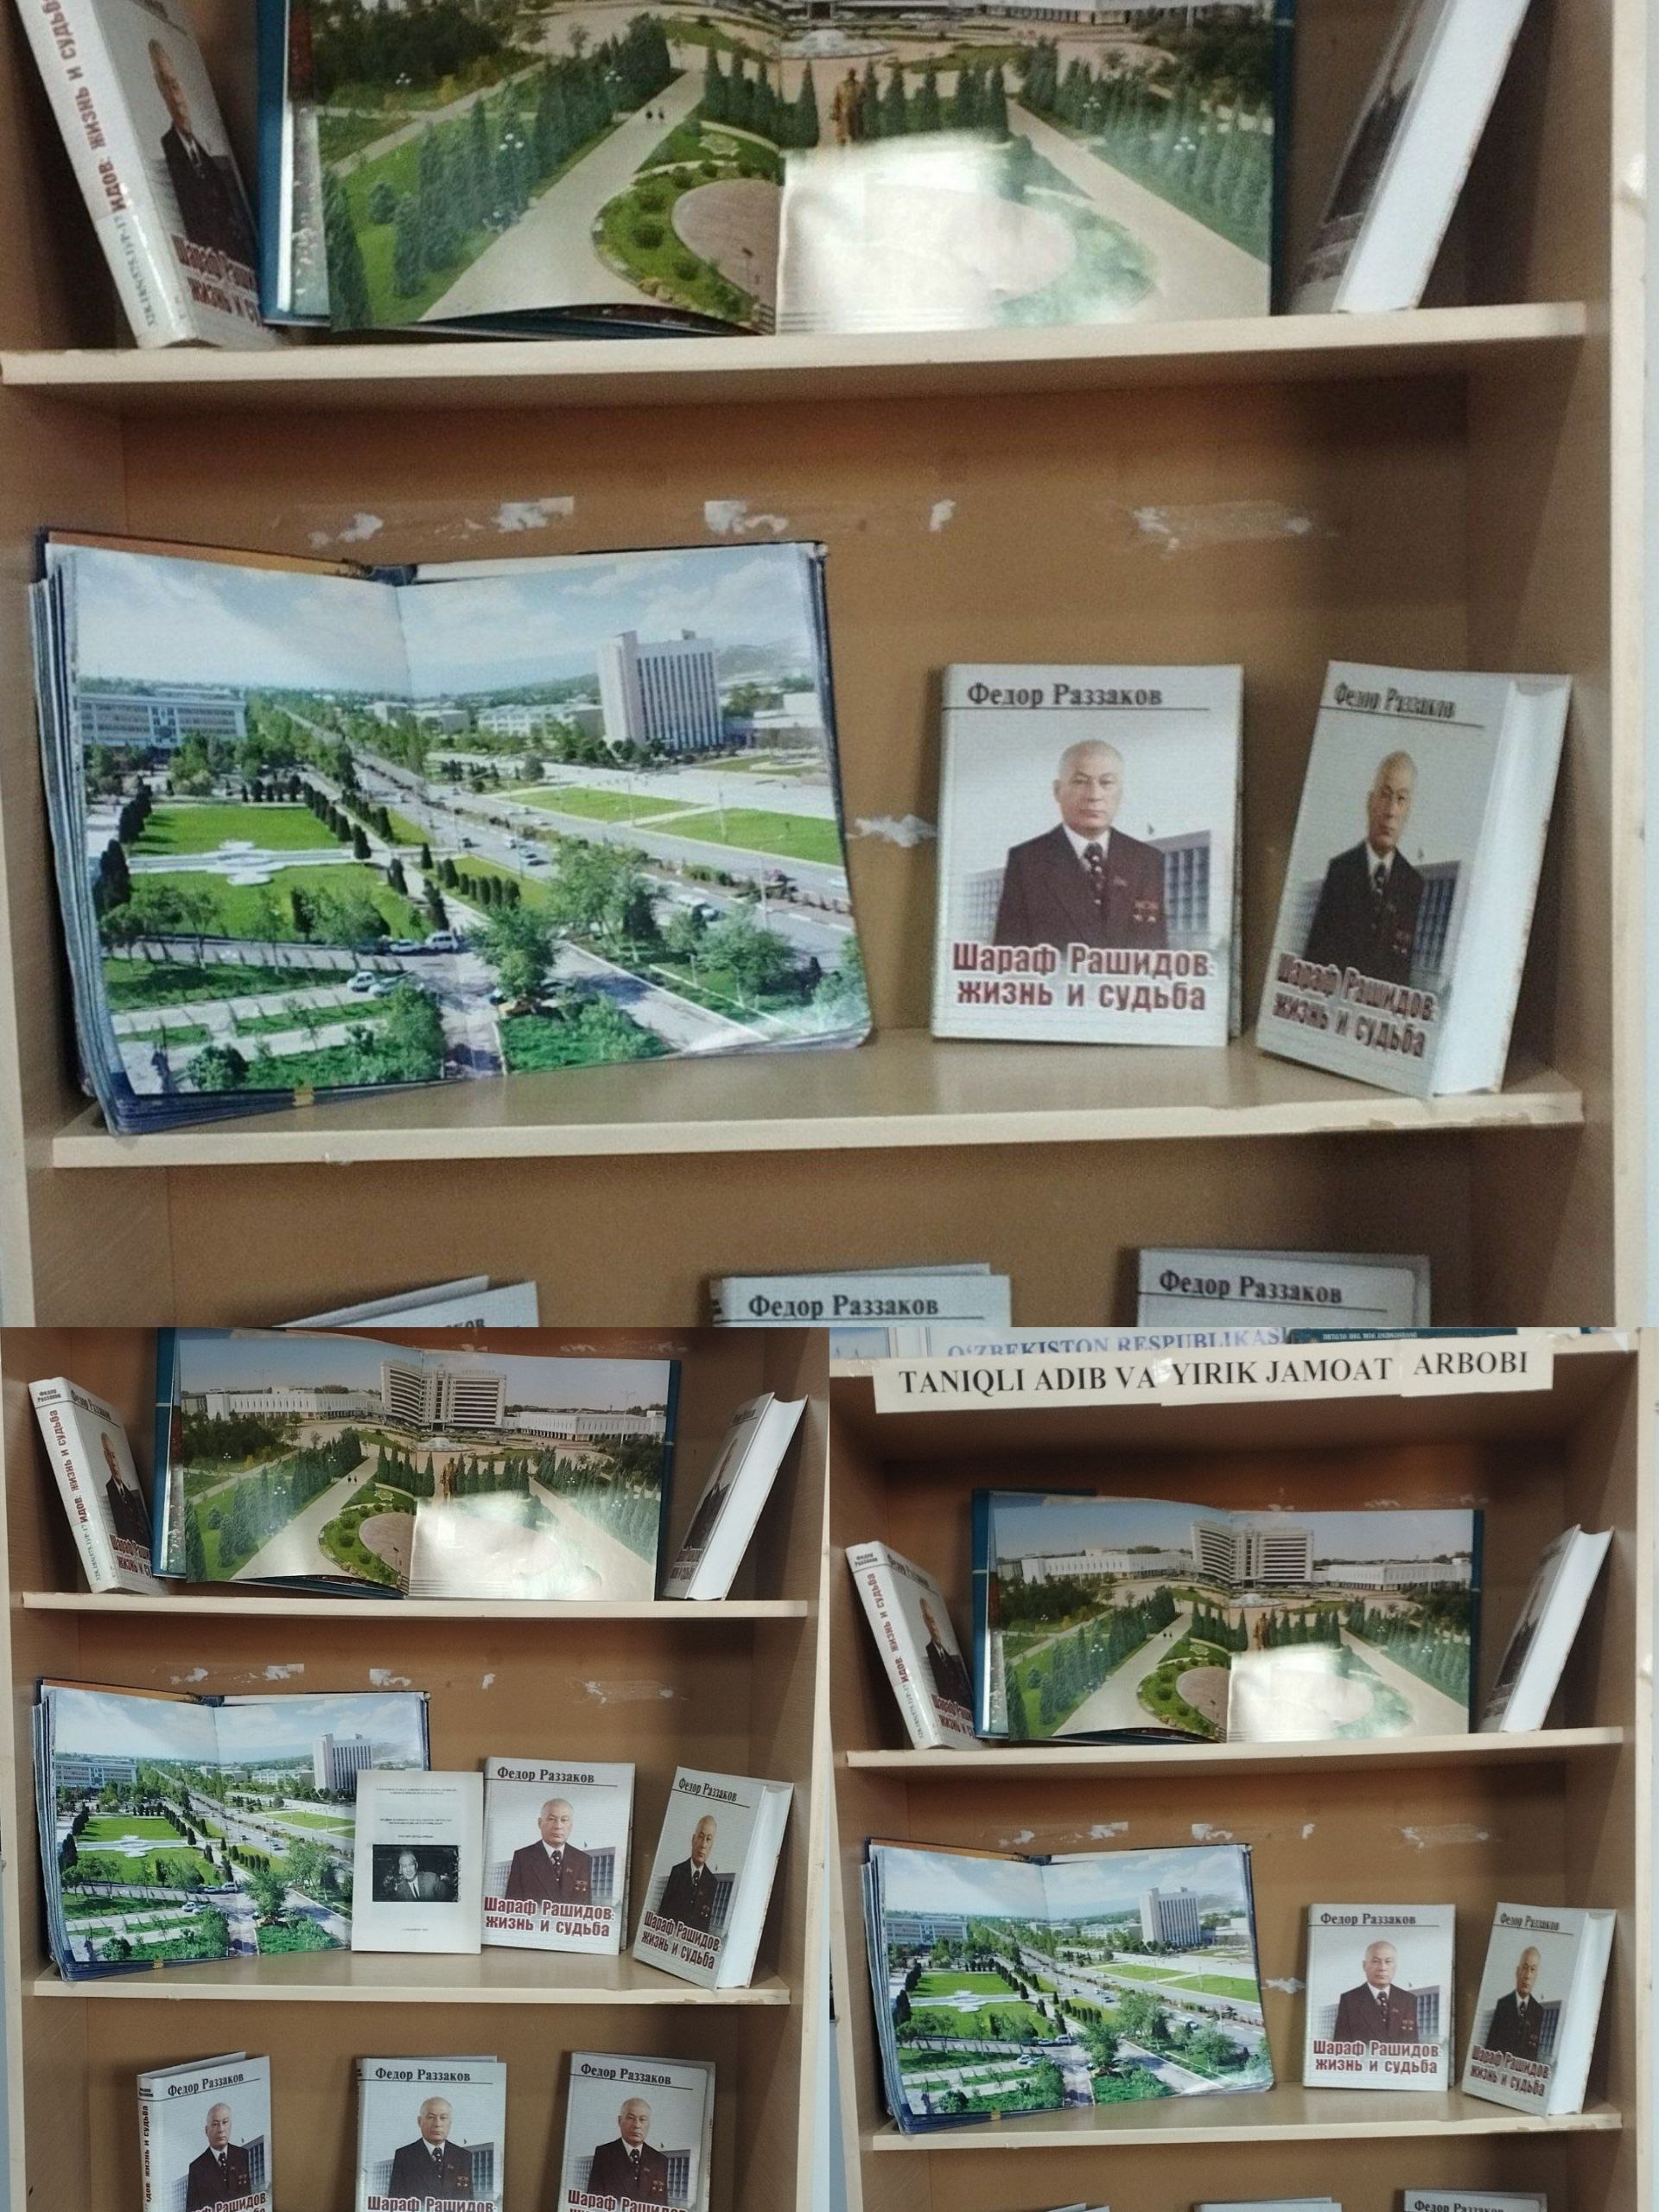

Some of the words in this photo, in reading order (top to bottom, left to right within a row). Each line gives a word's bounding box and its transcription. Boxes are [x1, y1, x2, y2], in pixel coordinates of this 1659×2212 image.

[41, 0, 76, 60] судьб
[66, 66, 85, 81] и
[967, 682, 1044, 709] Федор
[1052, 683, 1163, 706] Раззаков
[953, 942, 1056, 976] Шараф
[1277, 953, 1338, 999] Шараф
[957, 980, 1052, 1007] жизнь
[1067, 982, 1084, 1007] и
[1099, 982, 1207, 1012] судьба
[1273, 993, 1328, 1031] жизнь
[1336, 1009, 1349, 1037] и
[1356, 1012, 1426, 1058] судьба
[1159, 1269, 1231, 1300] Федор
[1240, 1275, 1343, 1304] Раззаков
[748, 1294, 823, 1319] Федор
[832, 1294, 939, 1316] Раззаков
[899, 1368, 1026, 1396] TANIQLI
[1035, 1367, 1107, 1390] ADIB
[1115, 1365, 1156, 1389] VA
[1172, 1360, 1257, 1386] YIRIK
[1265, 1357, 1393, 1382] JAMOAT
[1414, 1351, 1528, 1376] ARBOBI
[49, 1409, 66, 1446] судьба
[65, 1459, 80, 1491] жизнь
[867, 1573, 885, 1609] судьба
[497, 1766, 536, 1782] Федор
[540, 1769, 594, 1783] Раззаков
[678, 1777, 702, 1796] Федор
[703, 1783, 737, 1802] Раззаков
[484, 1897, 537, 1916] Шараф
[1320, 1912, 1358, 1926] Федор
[1363, 1912, 1416, 1924] Раззаков
[486, 1916, 533, 1931] жизнь
[540, 1920, 549, 1932] и
[556, 1921, 609, 1937] судьба
[645, 1911, 674, 1936] Шараф
[641, 1930, 668, 1951] жизнь
[671, 1942, 678, 1955] и
[681, 1945, 715, 1969] судьба
[1313, 2040, 1364, 2056] Шараф
[375, 2068, 413, 2082] Федор
[417, 2069, 471, 2082] Раззаков
[581, 2063, 616, 2080] Федор
[620, 2069, 671, 2085] Раззаков
[1315, 2059, 1363, 2071] жизнь
[1370, 2060, 1378, 2072] и
[1384, 2059, 1437, 2075] судьба
[168, 2083, 200, 2096] Федор
[201, 2074, 244, 2089] Раззаков
[1510, 2074, 1545, 2096] судьба
[367, 2196, 420, 2212] Шараф
[568, 2190, 616, 2211] Шараф
